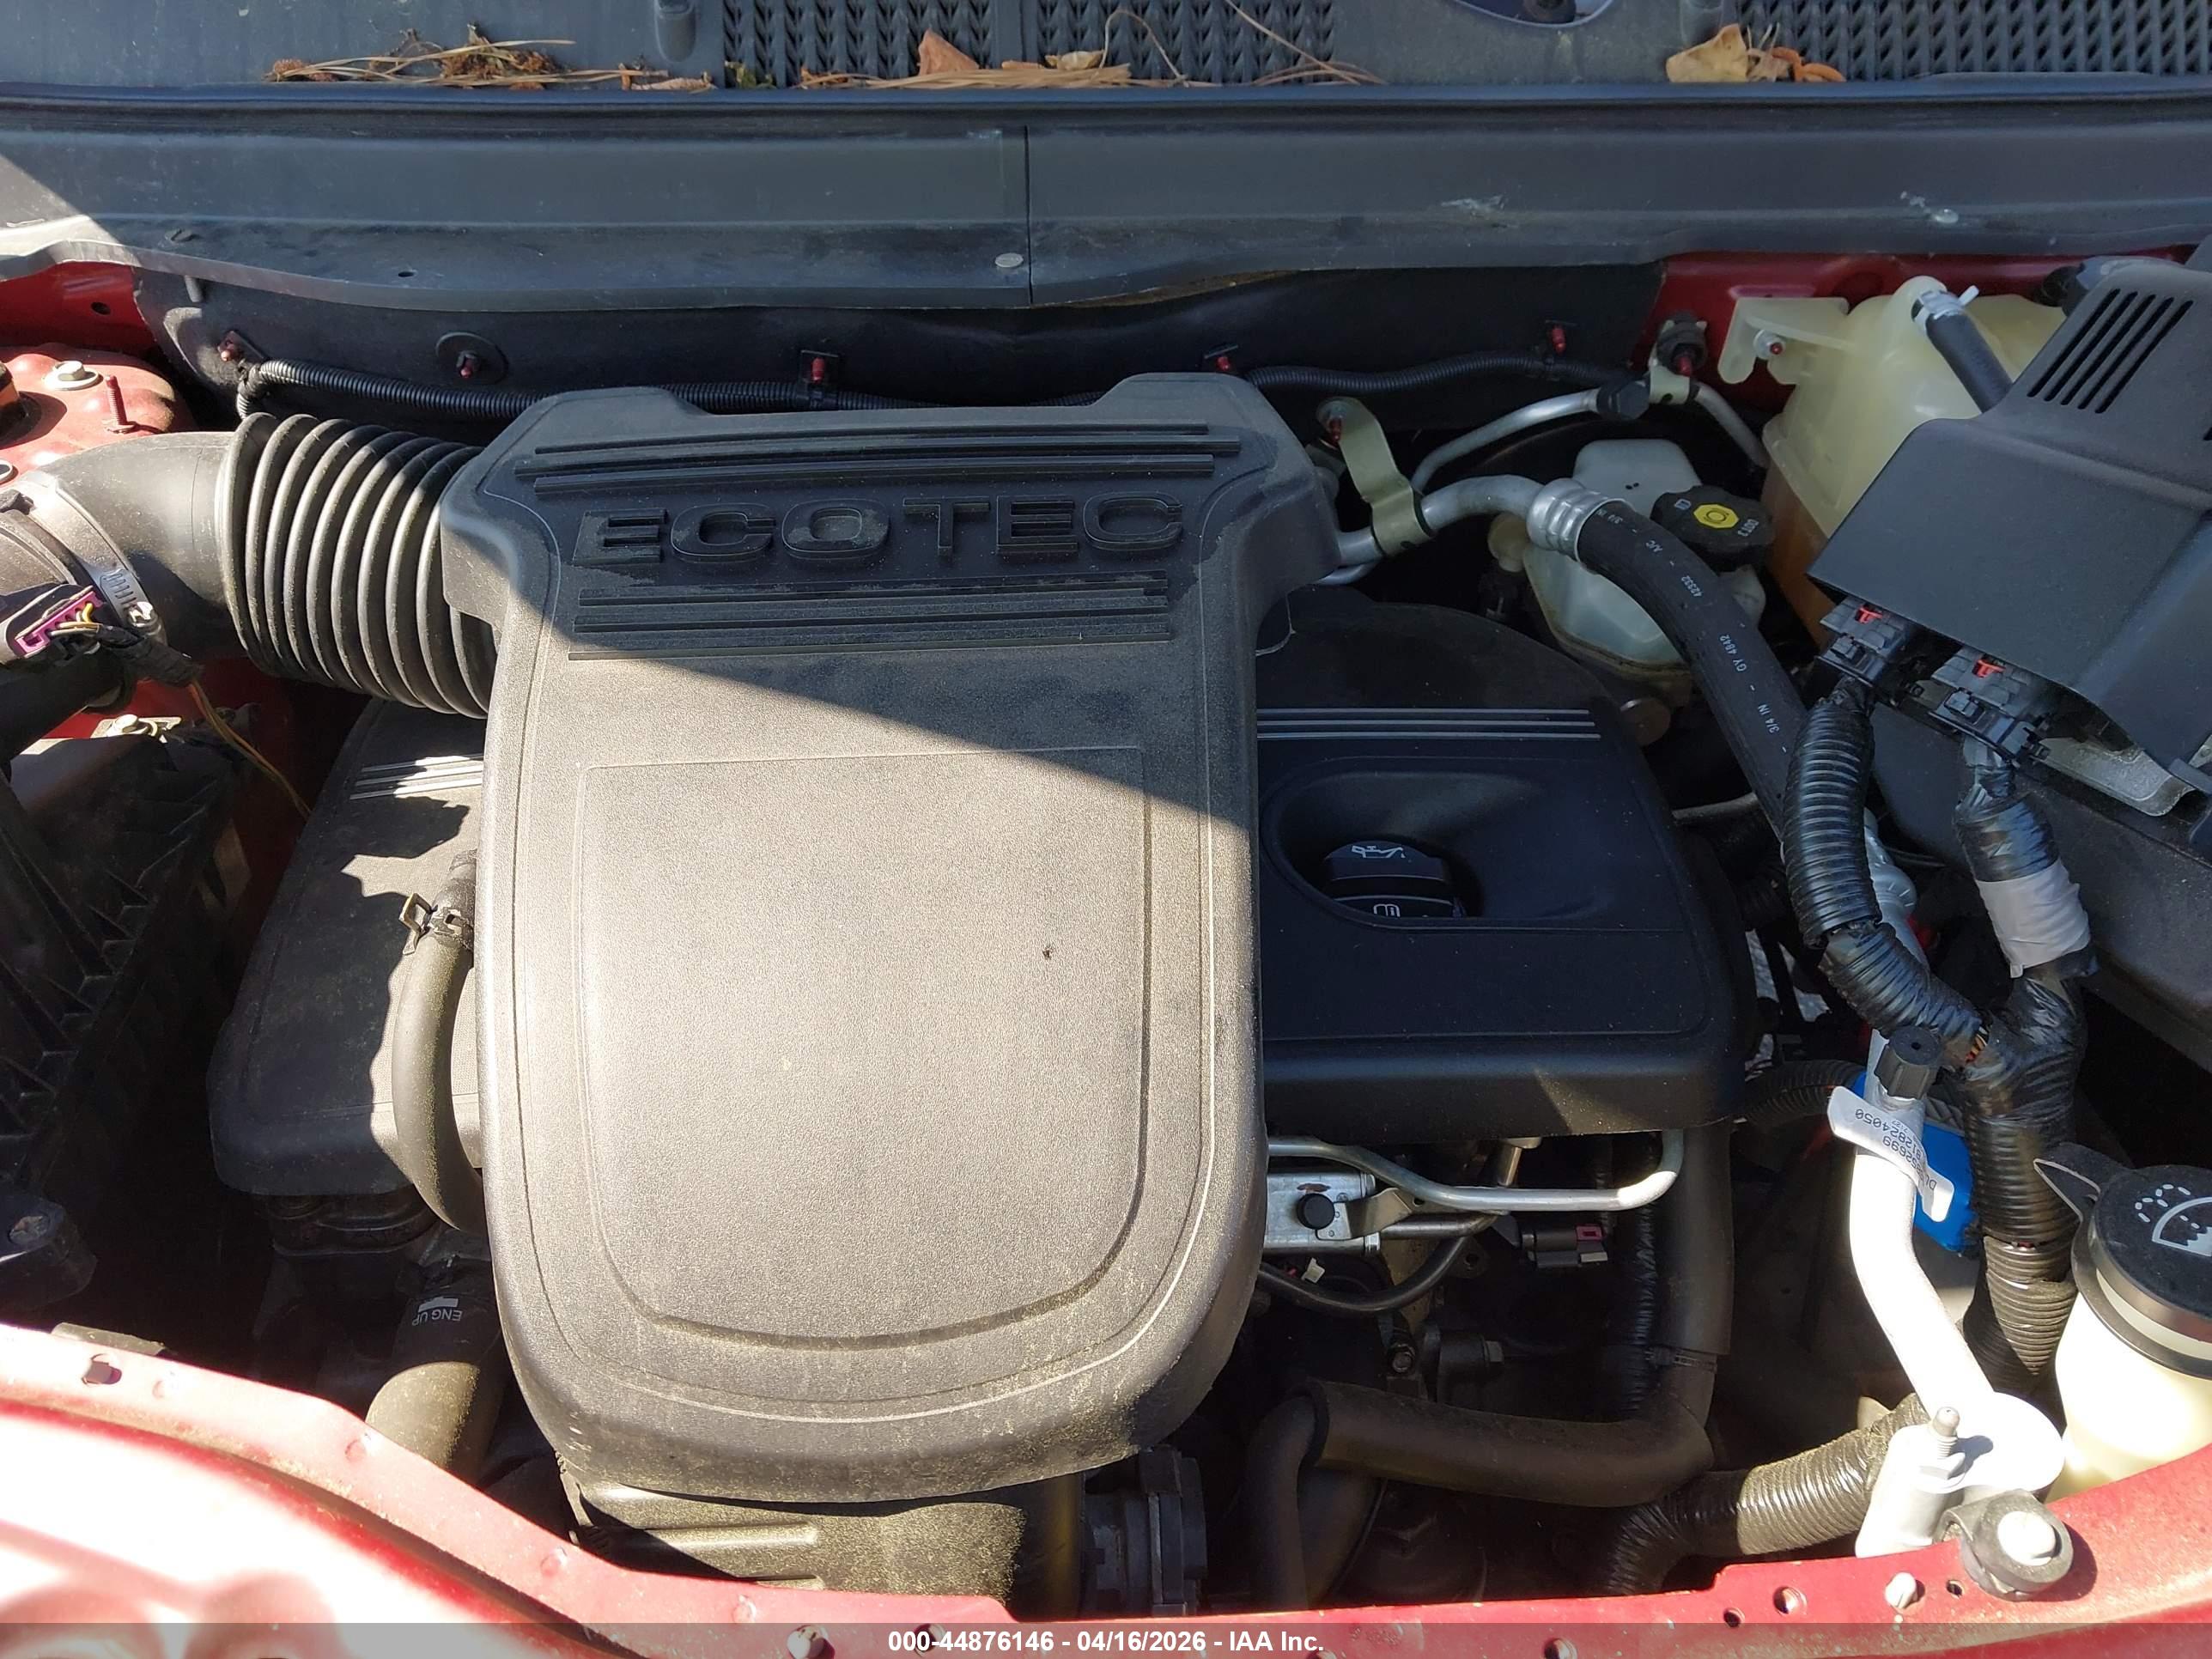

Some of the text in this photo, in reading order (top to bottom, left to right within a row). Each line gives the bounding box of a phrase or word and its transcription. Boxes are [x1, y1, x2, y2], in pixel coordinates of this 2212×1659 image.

[573, 491, 1184, 566] ECOTEC
[1732, 658, 1747, 672] GY
[1757, 703, 1771, 715] IN
[1765, 718, 1780, 733] 3/4
[411, 1308, 463, 1326] ENG UP
